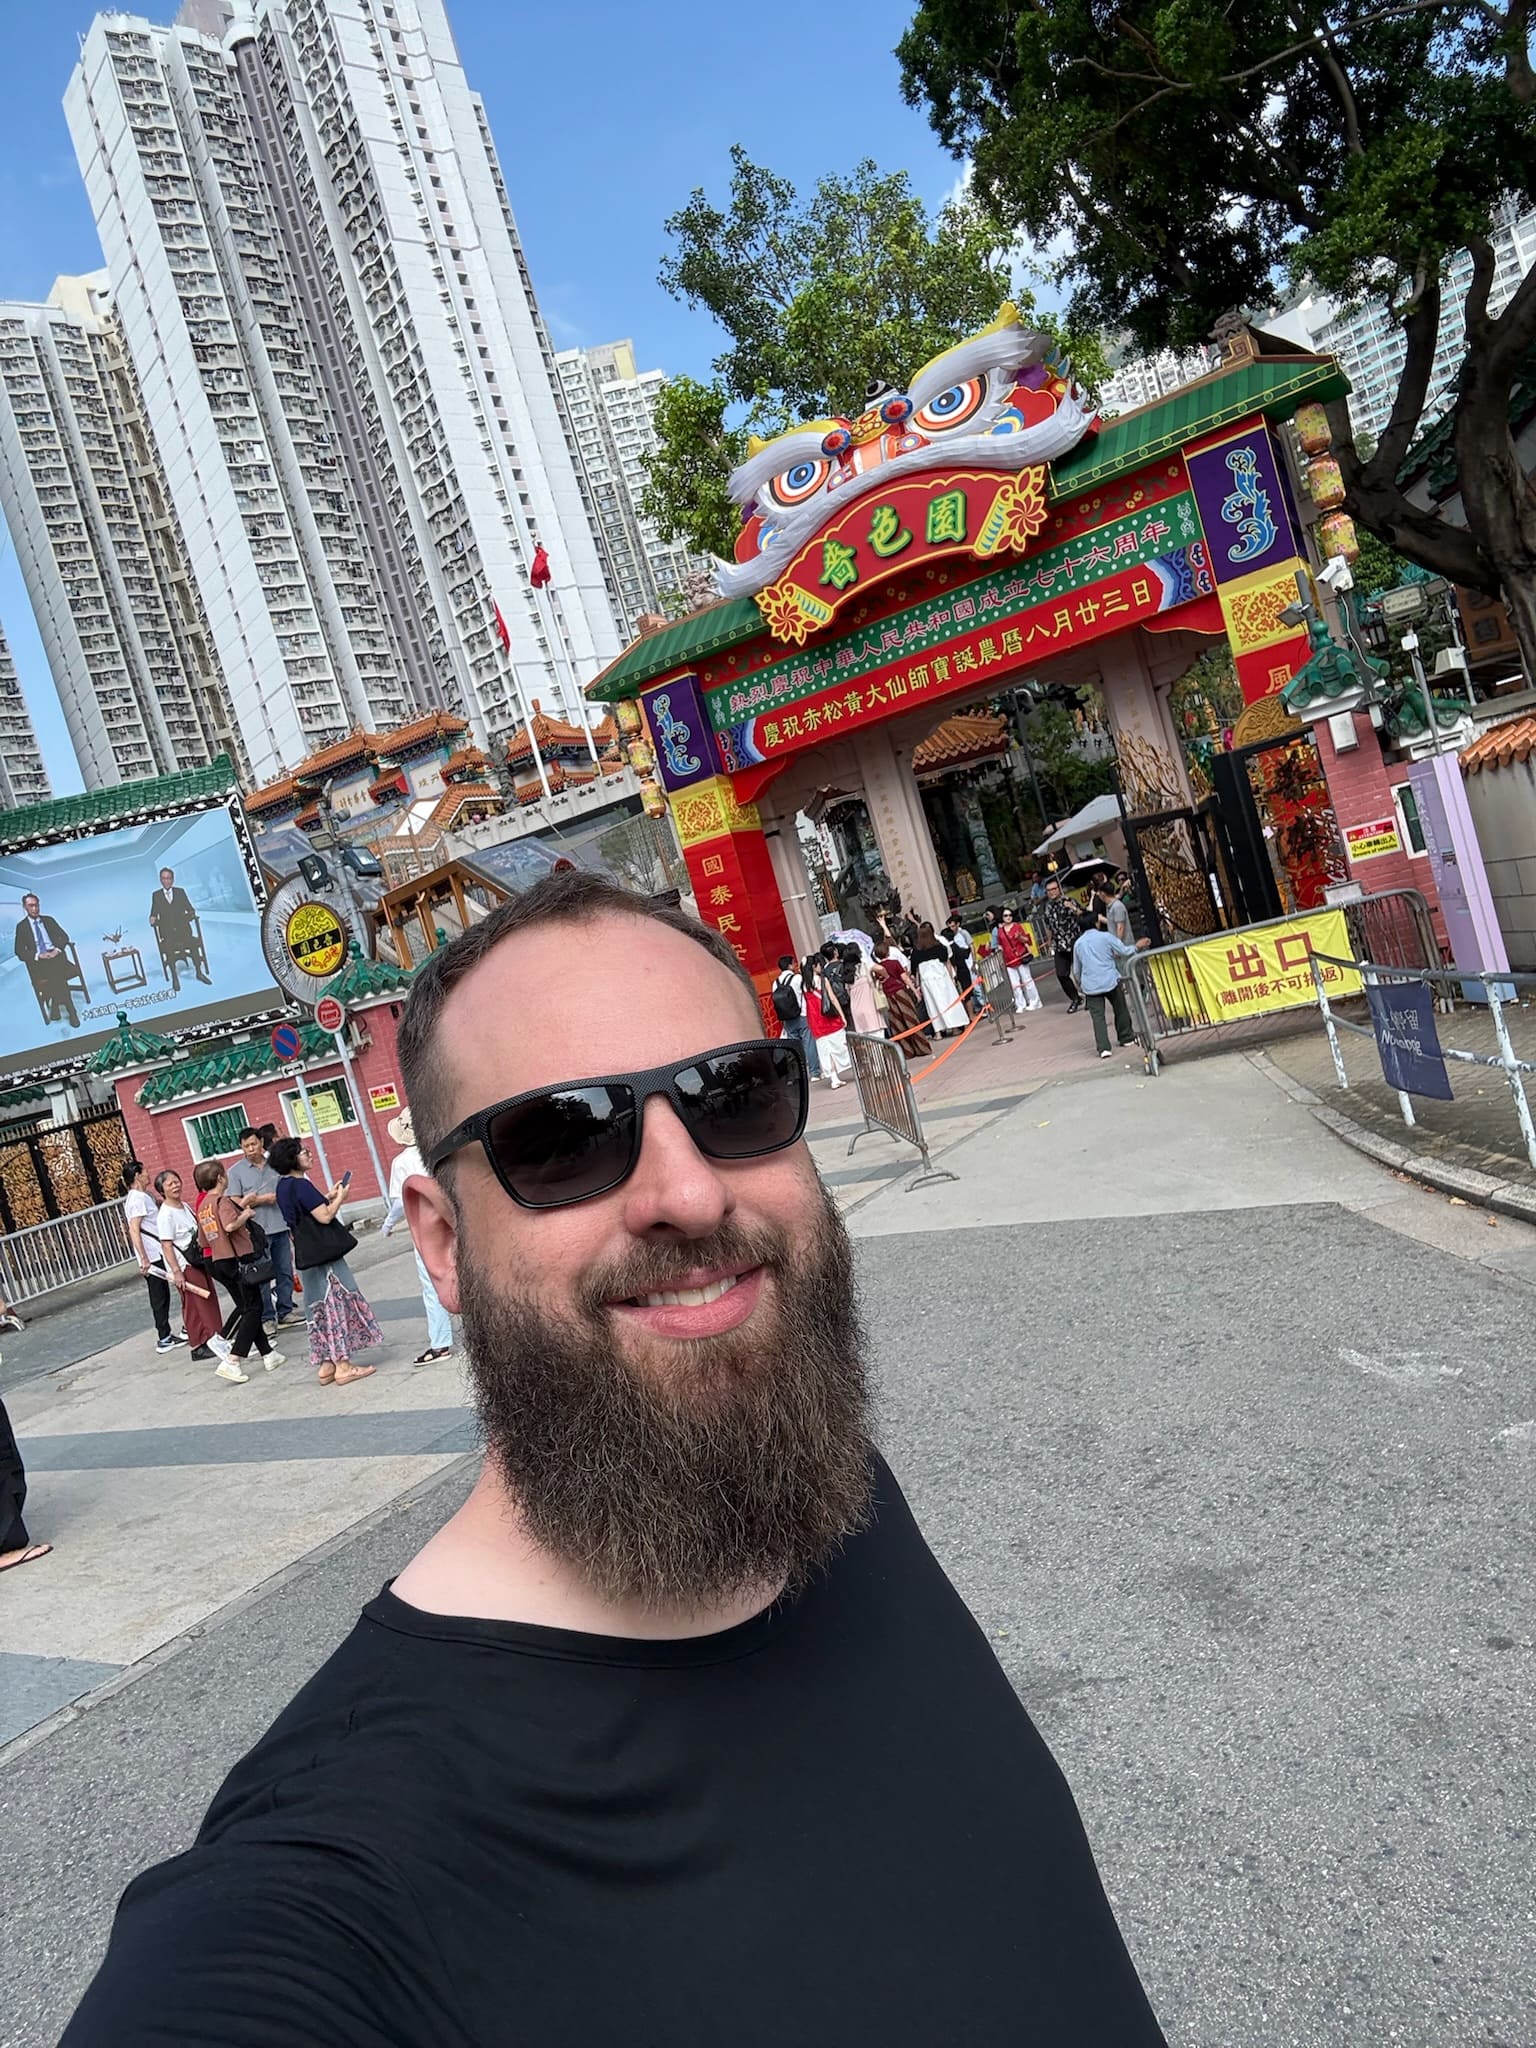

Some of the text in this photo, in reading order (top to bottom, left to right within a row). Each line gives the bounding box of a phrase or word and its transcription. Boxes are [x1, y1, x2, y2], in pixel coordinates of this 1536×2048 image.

[729, 520, 1171, 713] 熱烈慶祝中華人民共和國成立七十六周年
[702, 854, 747, 961] 國泰民
[1226, 931, 1313, 983] 出口
